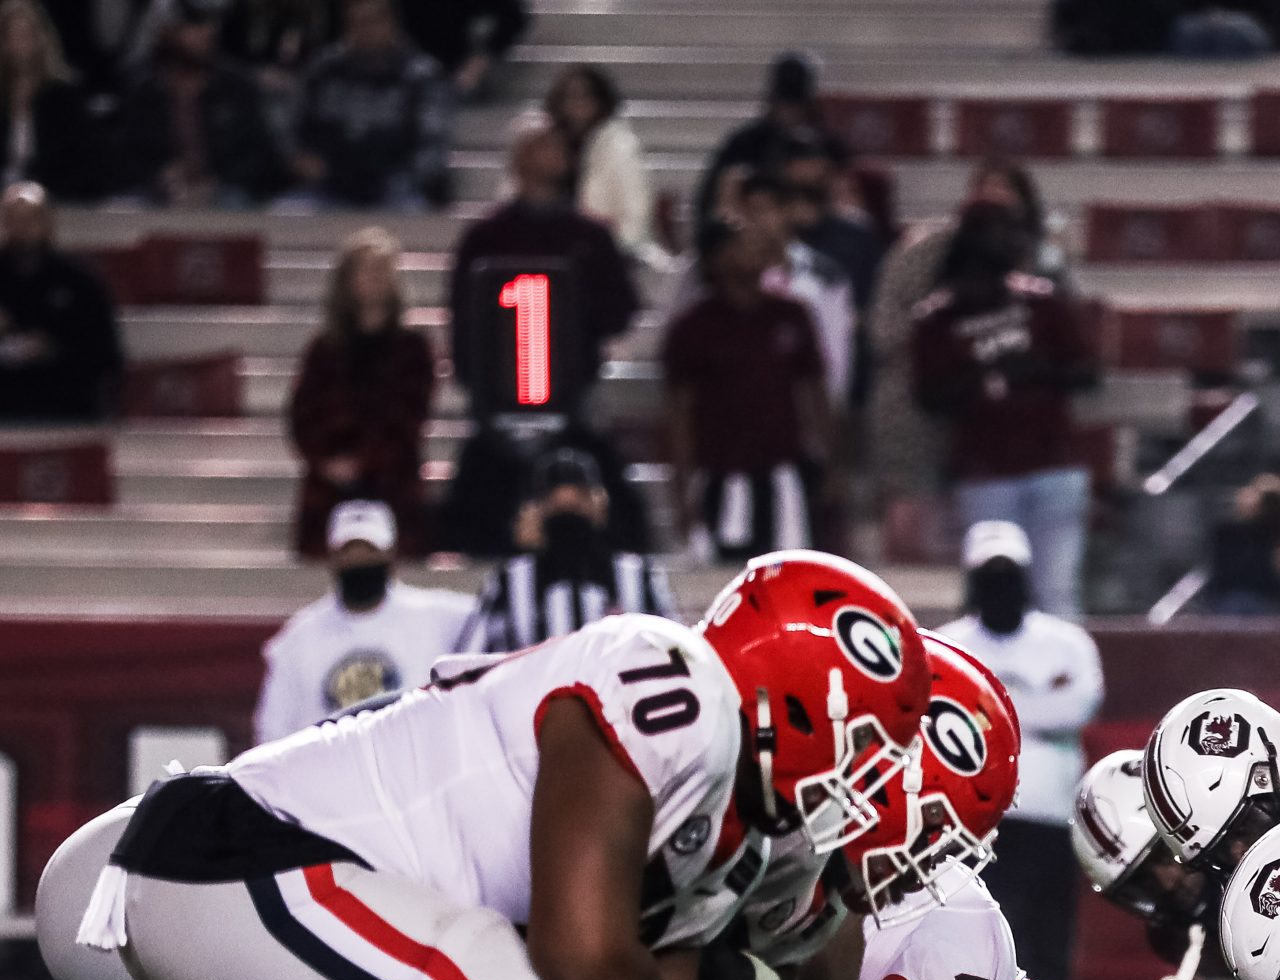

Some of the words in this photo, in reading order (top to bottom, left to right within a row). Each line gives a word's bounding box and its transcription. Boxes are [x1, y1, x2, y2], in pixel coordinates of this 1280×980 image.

[499, 273, 551, 404] 1
[832, 605, 904, 683] G
[920, 695, 987, 777] G
